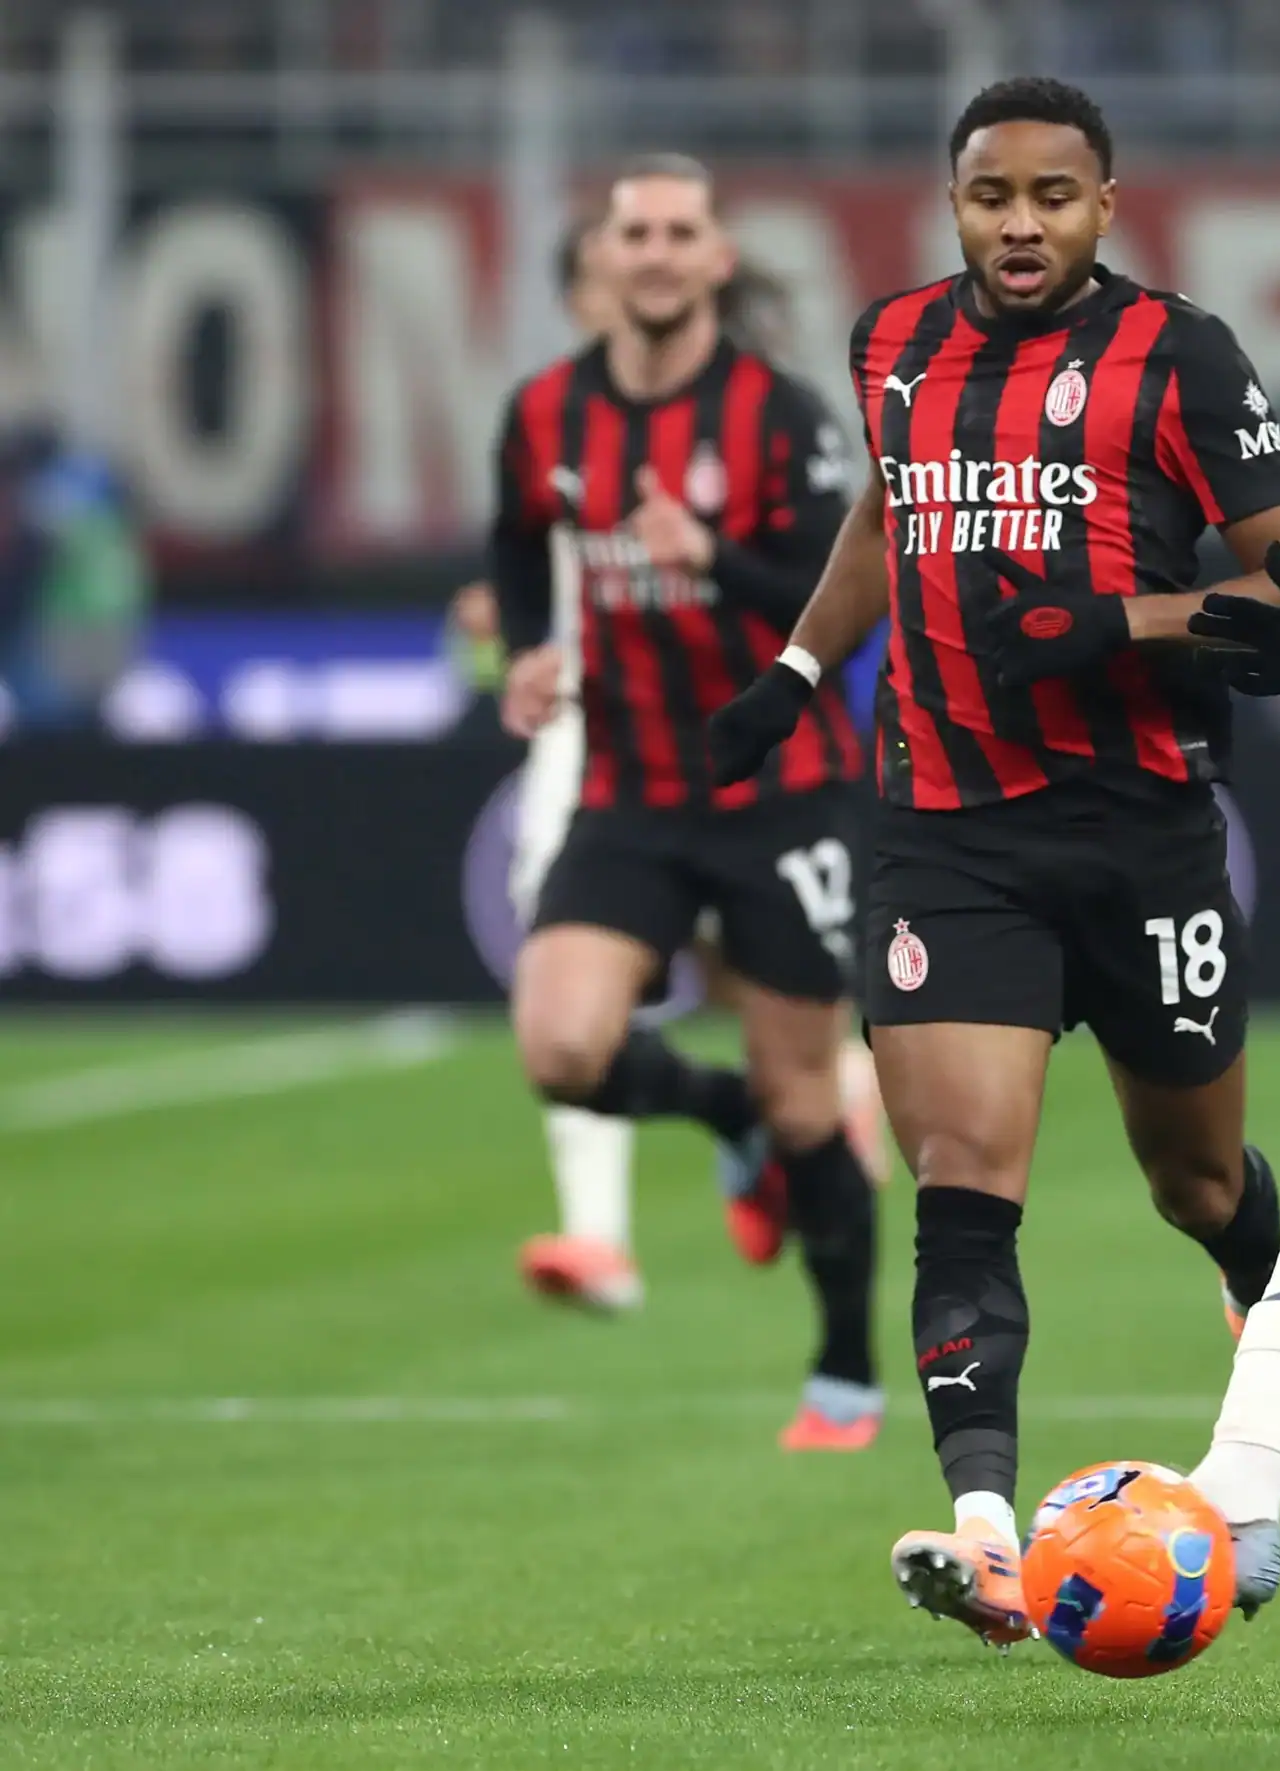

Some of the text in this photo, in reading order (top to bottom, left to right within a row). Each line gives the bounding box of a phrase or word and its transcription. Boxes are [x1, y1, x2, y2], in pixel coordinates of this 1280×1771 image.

[879, 448, 1098, 507] Emirates
[904, 509, 1063, 555] FLY BETTER
[1145, 909, 1227, 1005] 18
